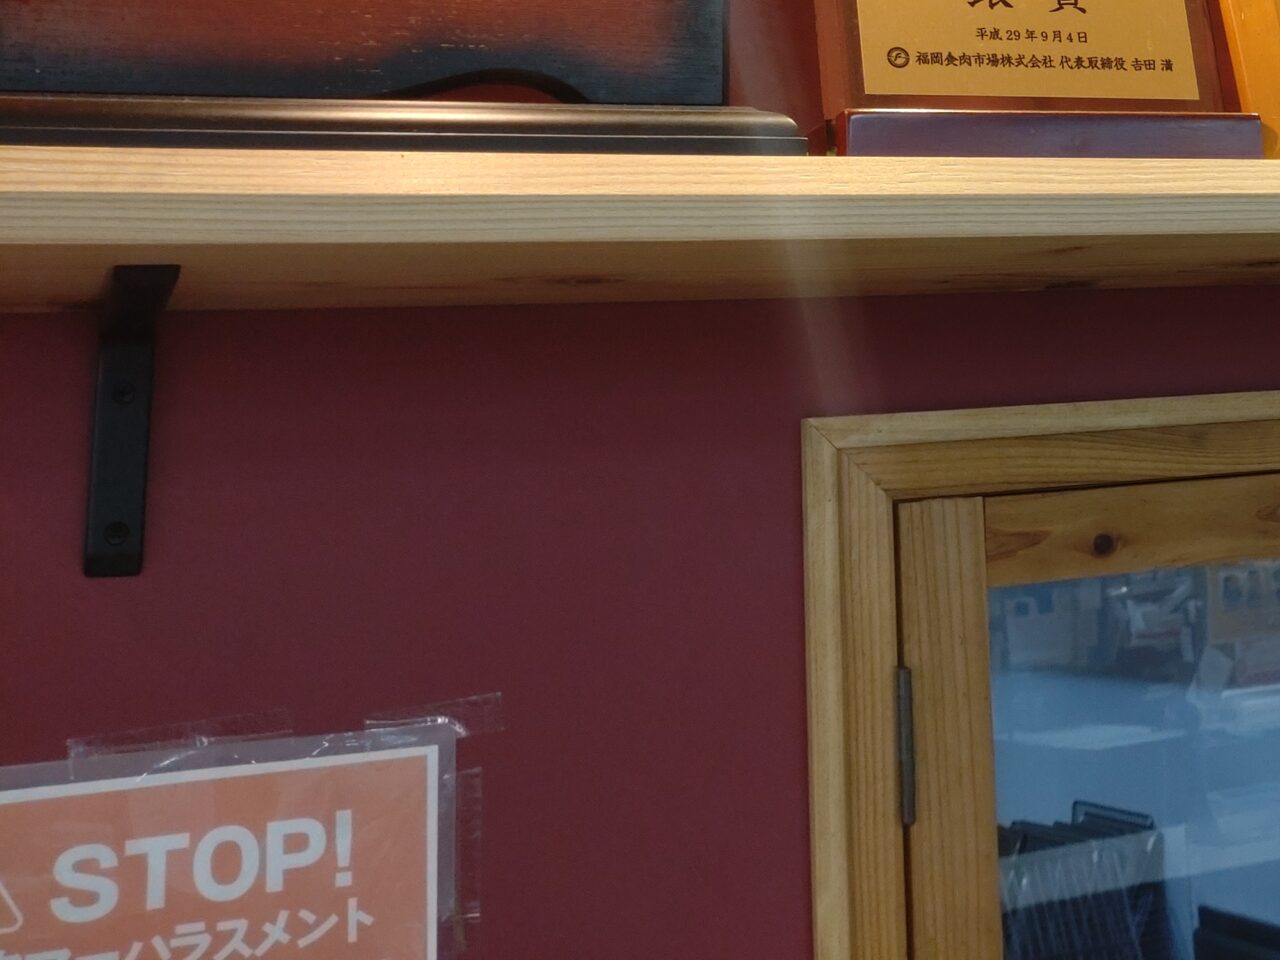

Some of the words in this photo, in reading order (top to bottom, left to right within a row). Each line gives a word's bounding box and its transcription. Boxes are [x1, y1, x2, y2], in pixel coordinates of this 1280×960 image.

[975, 27, 1089, 44] 平成29年9月4日
[915, 50, 1056, 70] 福岡食肉市場株式会社
[1059, 54, 1128, 72] 代表取締役
[49, 808, 353, 924] STOP!
